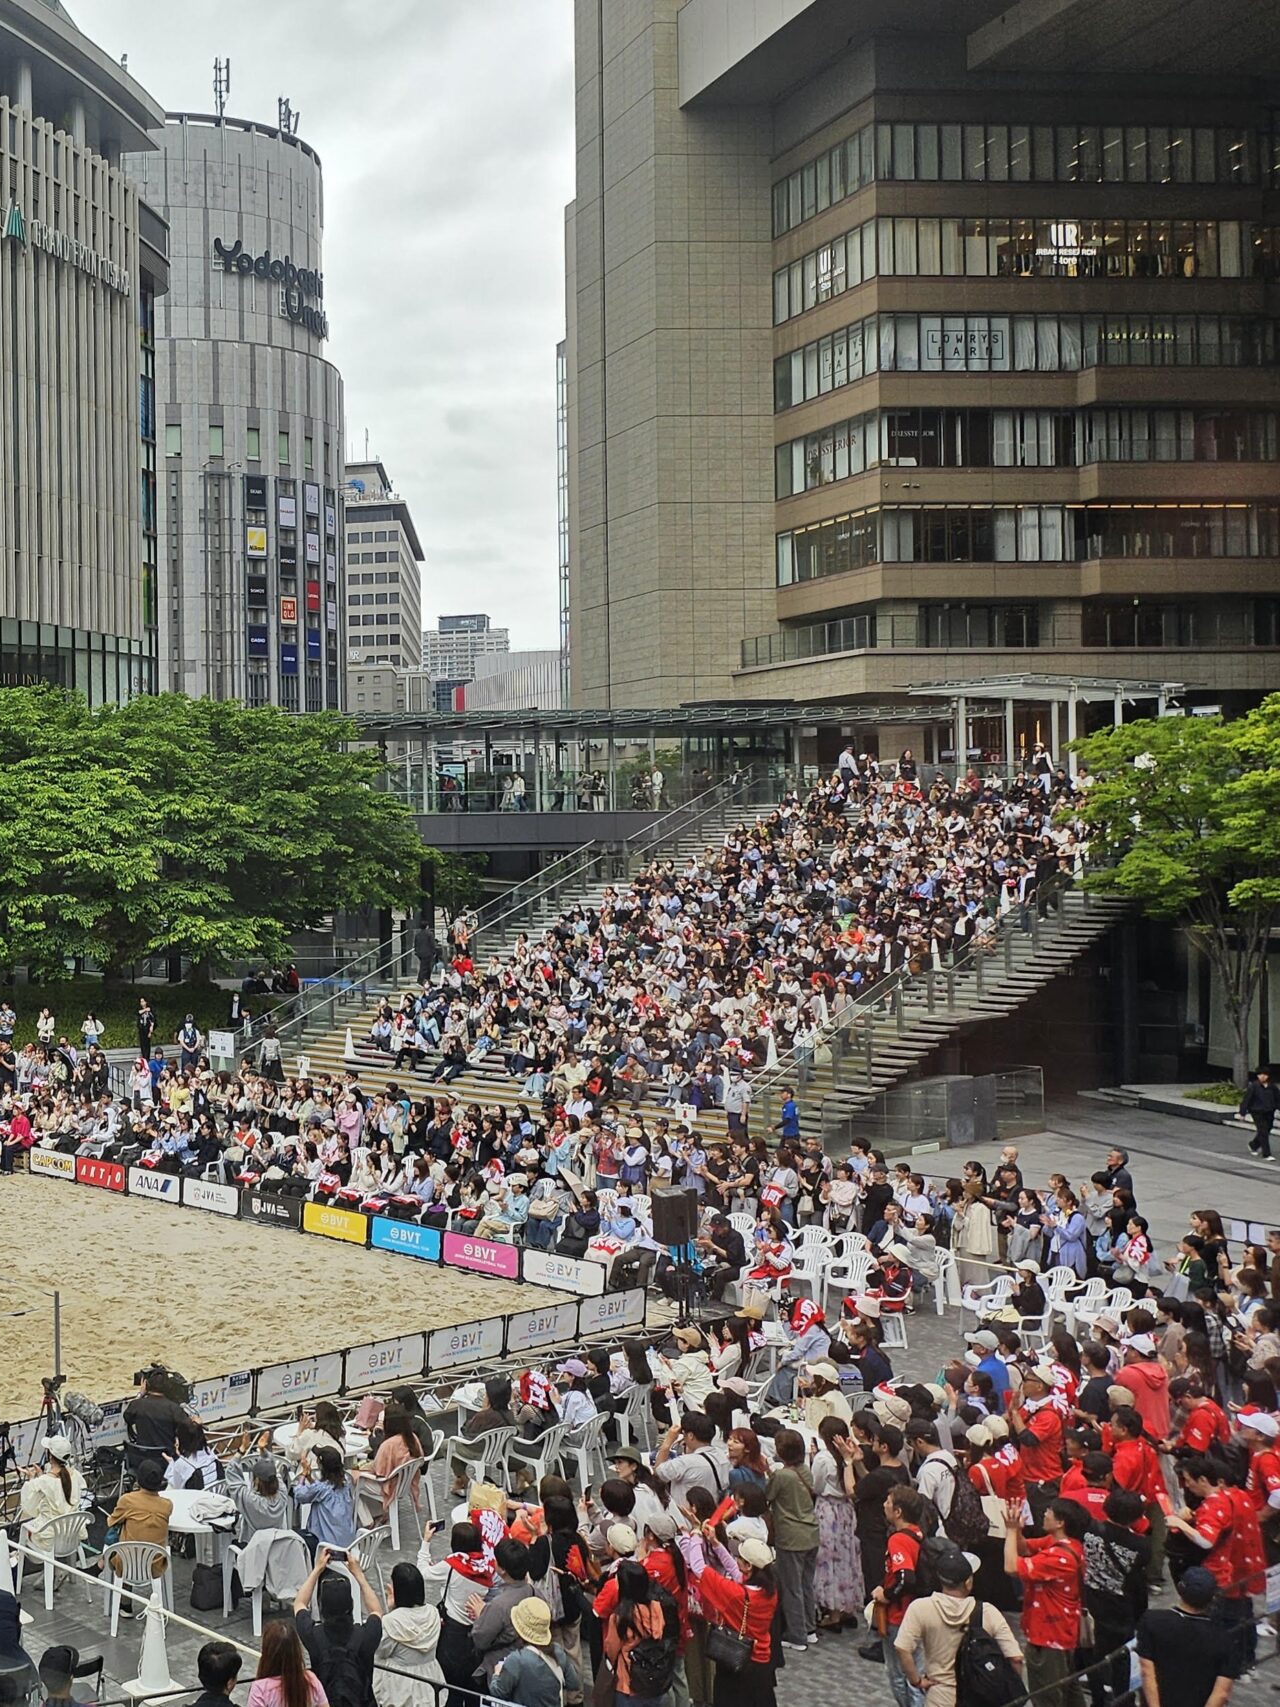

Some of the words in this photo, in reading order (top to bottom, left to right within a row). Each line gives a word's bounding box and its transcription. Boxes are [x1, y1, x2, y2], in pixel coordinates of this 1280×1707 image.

[214, 237, 323, 300] Yodobashi
[931, 333, 999, 344] LOWRYS
[308, 544, 318, 552] TCL
[283, 602, 294, 610] UNI
[32, 1152, 73, 1172] CAPCOM
[80, 1164, 121, 1186] AKTIO
[136, 1175, 160, 1191] ANA
[202, 1190, 215, 1201] JVA
[261, 1201, 276, 1215] JVA
[329, 1214, 350, 1228] BVT
[400, 1229, 422, 1245] BVT
[474, 1245, 497, 1262] BVT
[556, 1263, 581, 1280] BVT
[608, 1299, 627, 1315] BVT
[538, 1315, 559, 1331] BVT
[461, 1331, 483, 1348] BVT
[380, 1347, 403, 1366] BVT
[294, 1367, 319, 1387] BVT
[201, 1387, 227, 1407] BVT
